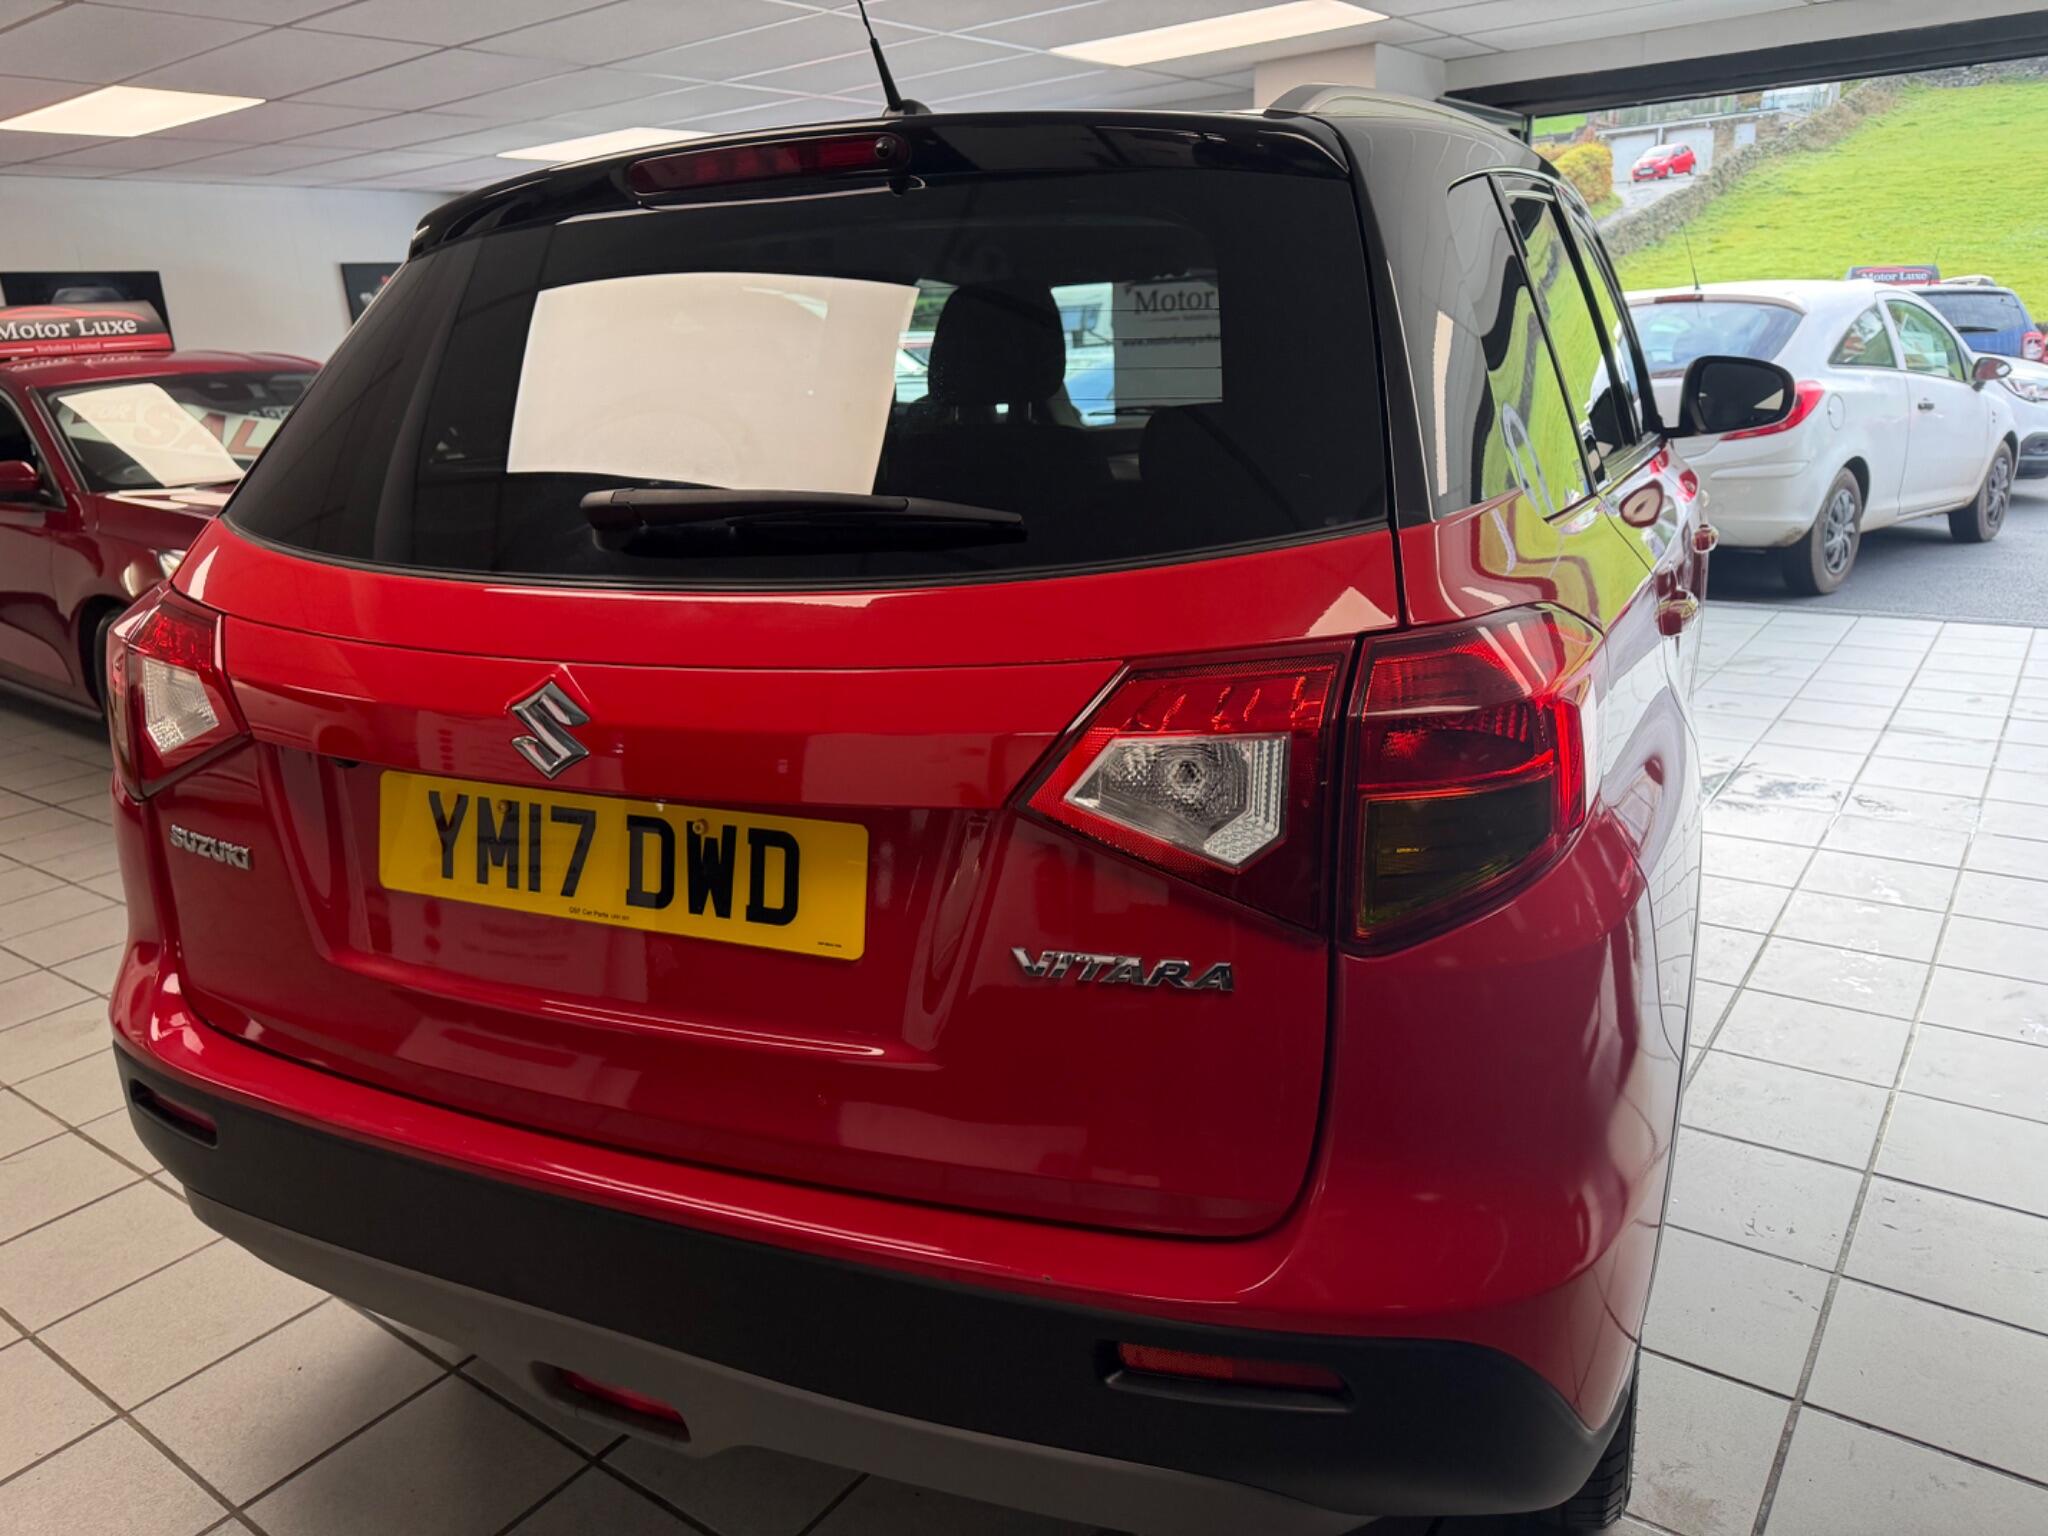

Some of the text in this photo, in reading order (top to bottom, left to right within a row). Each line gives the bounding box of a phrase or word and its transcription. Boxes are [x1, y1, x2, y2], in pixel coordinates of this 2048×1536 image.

[1134, 288, 1216, 314] Motor
[0, 318, 138, 340] Motor Luxe
[170, 823, 250, 871] SUZUKI
[427, 790, 801, 927] YM17 DWD
[1011, 947, 1235, 992] VITARA
